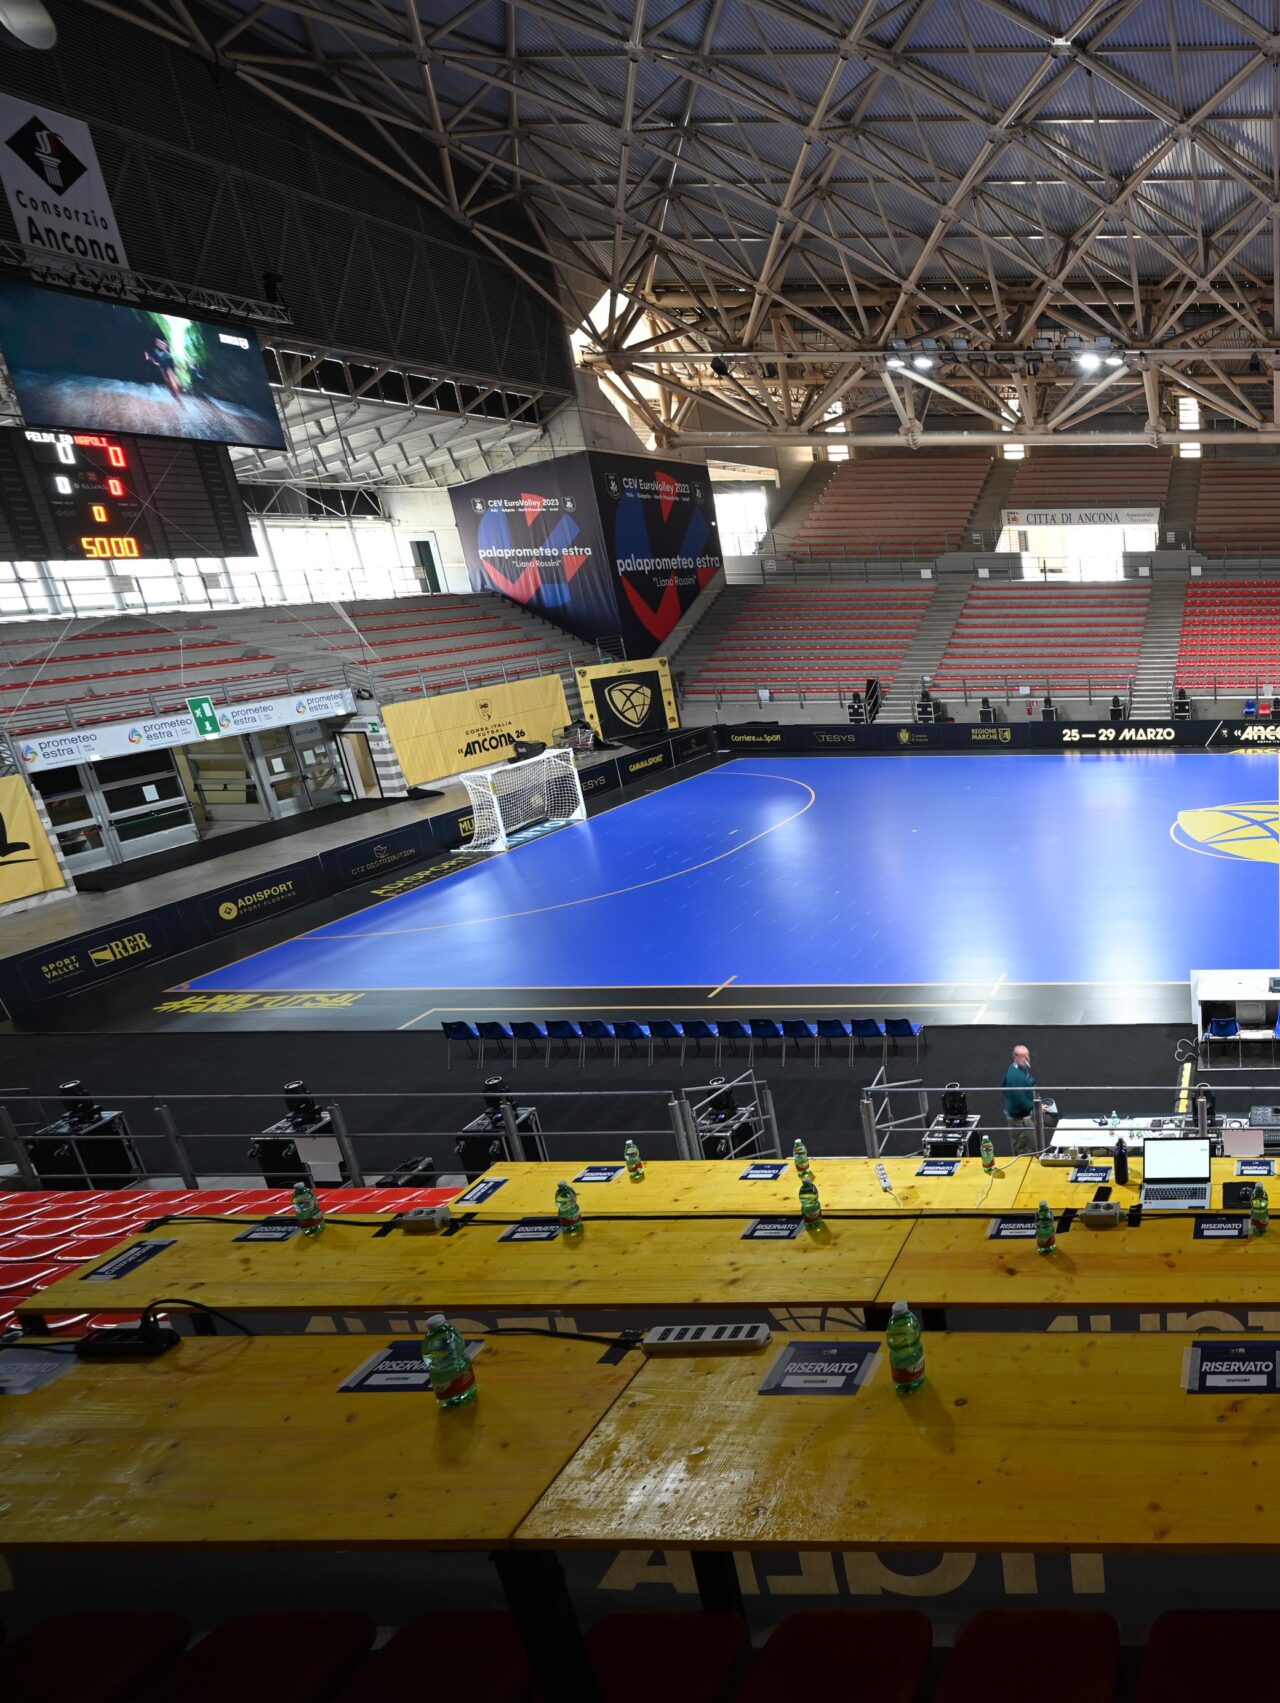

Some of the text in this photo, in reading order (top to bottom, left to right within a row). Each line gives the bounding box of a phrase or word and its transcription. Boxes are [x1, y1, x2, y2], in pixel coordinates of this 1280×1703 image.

[15, 189, 108, 230] Consorzio
[27, 215, 120, 265] Ancona
[74, 435, 108, 447] NAPOLI
[56, 443, 126, 467] 0 0
[55, 476, 72, 494] 0
[108, 479, 123, 496] 0
[622, 477, 690, 495] CEV EuroVolley 2023
[487, 498, 560, 508] CEV EuroVolley 2023
[91, 505, 107, 522] 0
[1026, 512, 1057, 525] CITTA'
[1061, 512, 1072, 525] DI
[1077, 512, 1121, 525] ANCONA
[478, 545, 593, 560] palaprometeo estra
[616, 553, 721, 577] palaprometeo estra
[230, 704, 274, 719] prometeo
[143, 718, 193, 734] prometeo
[233, 715, 257, 726] estra
[490, 720, 513, 730] ITALIA
[146, 729, 173, 741] estra
[819, 733, 856, 743] TESYS
[1061, 727, 1176, 741] 25 29 MARZO
[38, 733, 98, 752] prometeo
[464, 729, 526, 758] ANCONA 26
[42, 747, 75, 760] estra
[581, 776, 606, 791] ESYS
[367, 847, 417, 870] DISTRIBUTION
[237, 880, 294, 908] ADISPORT
[109, 932, 153, 961] RER
[41, 955, 77, 973] SPORT
[44, 962, 81, 979] VALLEY
[373, 1360, 431, 1371] RISERVA
[784, 1362, 858, 1374] RISERVATO
[1201, 1361, 1274, 1373] RISERVATO
